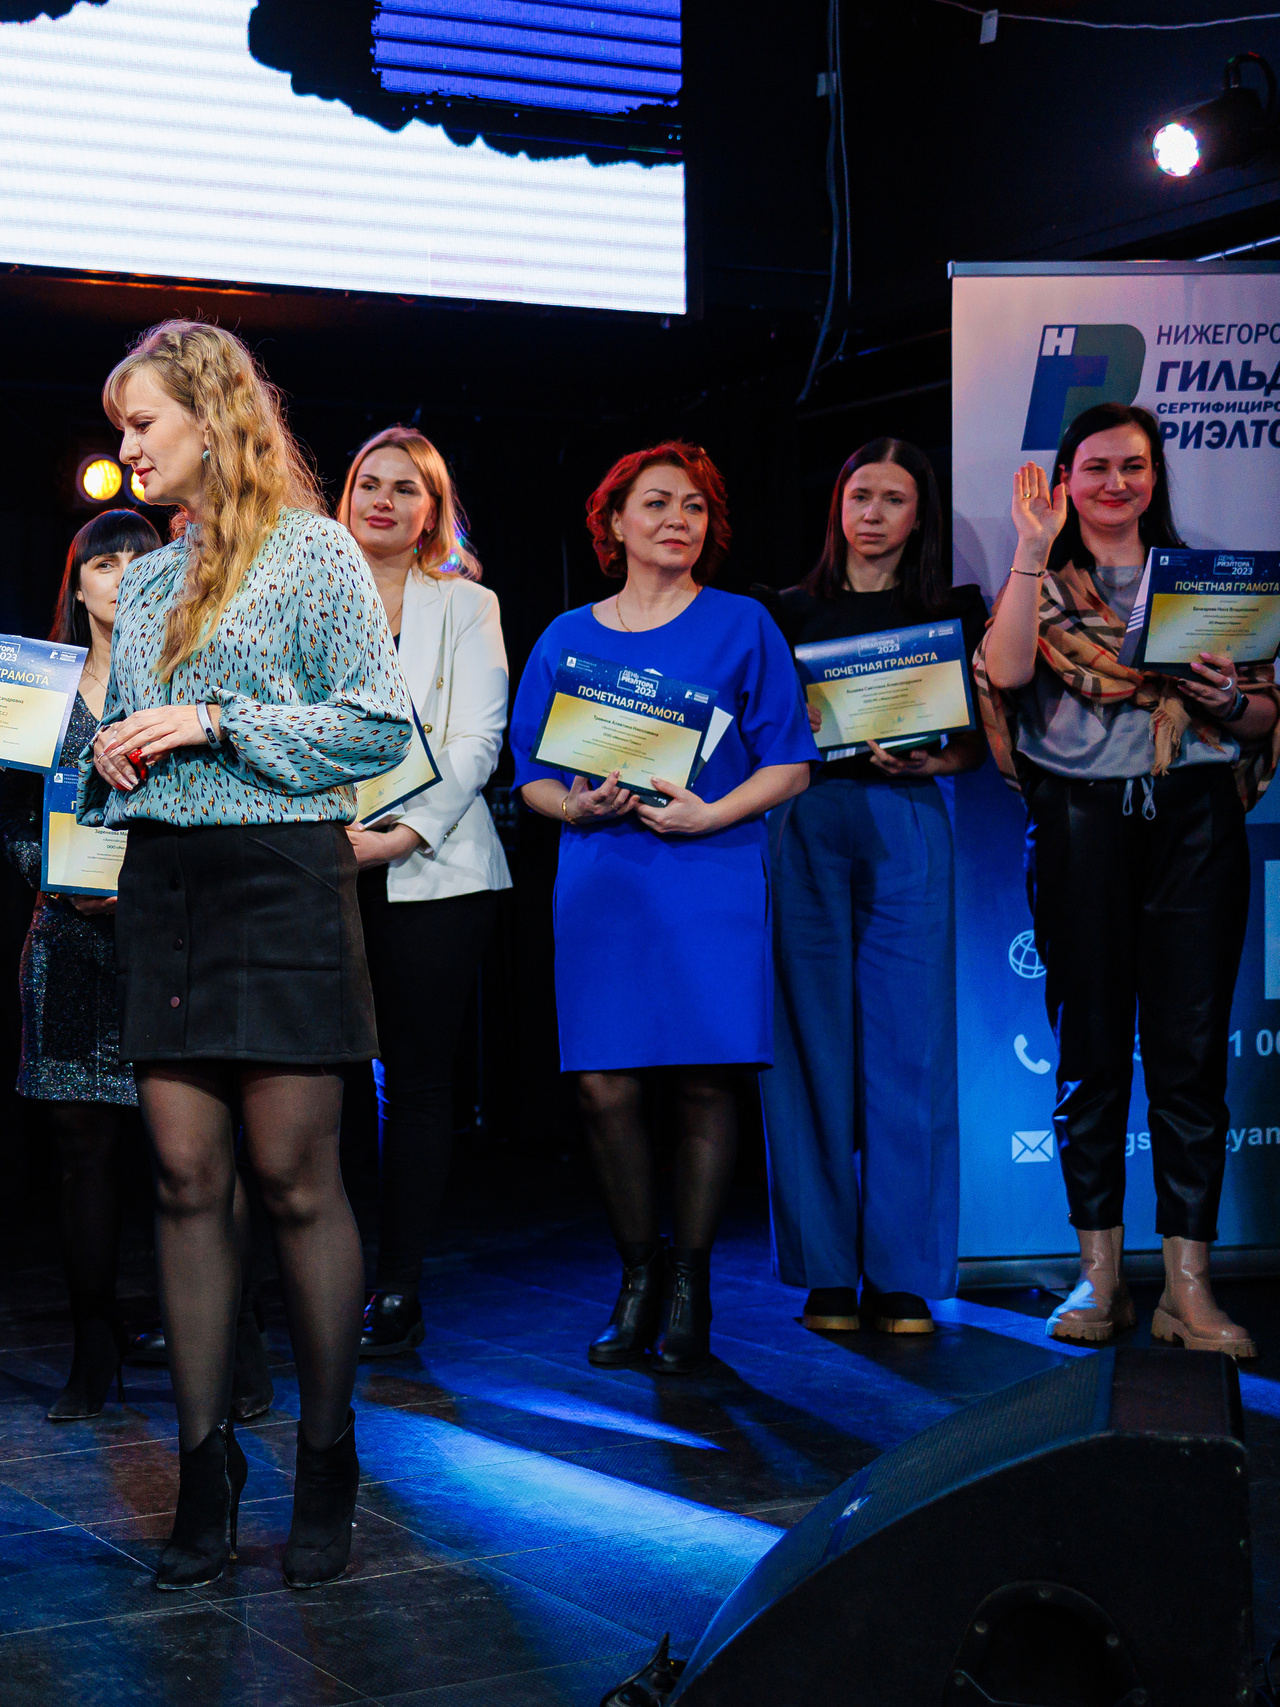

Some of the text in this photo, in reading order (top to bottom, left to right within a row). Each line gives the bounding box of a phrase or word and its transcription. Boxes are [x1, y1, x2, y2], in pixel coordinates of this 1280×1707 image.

[1175, 581, 1279, 592] ПОЧЕТНАЯ ГРАМОТА
[877, 643, 900, 654] 2023
[824, 651, 938, 678] ПОЧЕТНАЯ ГРАМОТА
[622, 676, 654, 689] РИЭЛТОРА
[634, 685, 657, 698] 2023
[578, 685, 685, 723] ПОЧЕТНАЯ ГРАМОТА
